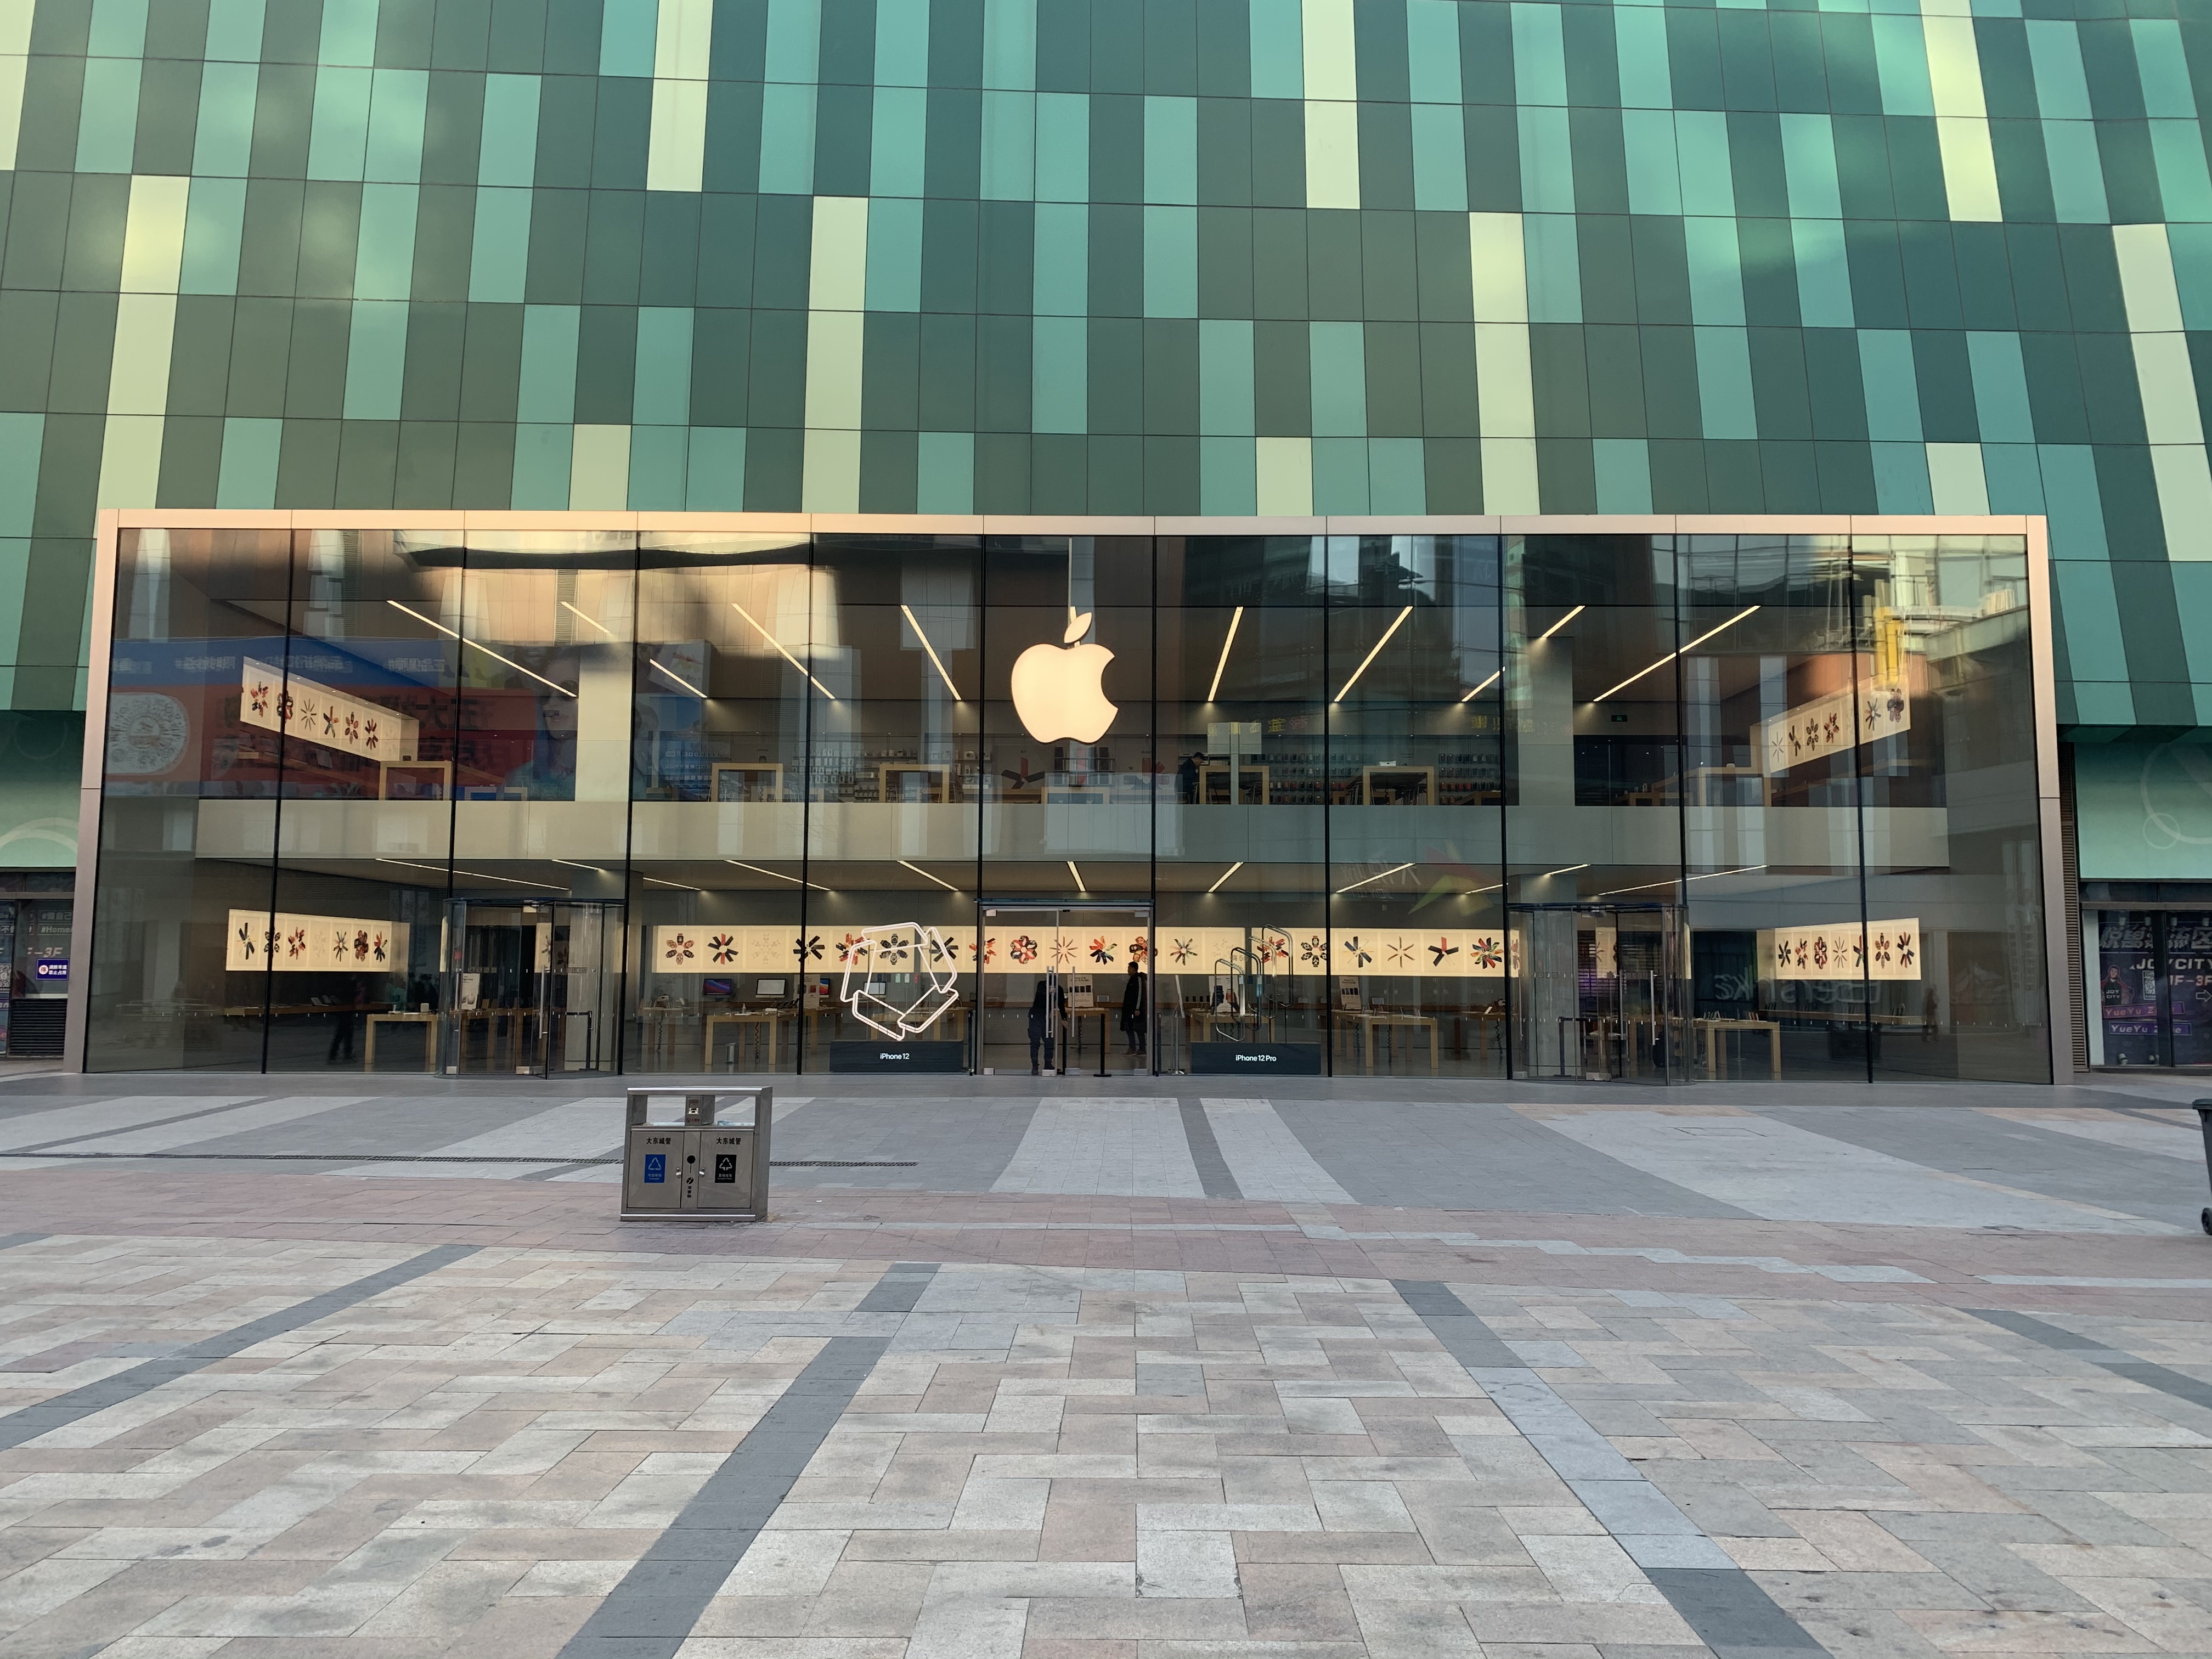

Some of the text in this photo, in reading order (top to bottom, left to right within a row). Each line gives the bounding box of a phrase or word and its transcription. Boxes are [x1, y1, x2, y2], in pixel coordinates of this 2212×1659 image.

[2106, 1007, 2142, 1016] YueYu
[2111, 1025, 2148, 1033] YueYu
[646, 1137, 671, 1145] 大东城管
[716, 1137, 742, 1145] 大东城管
